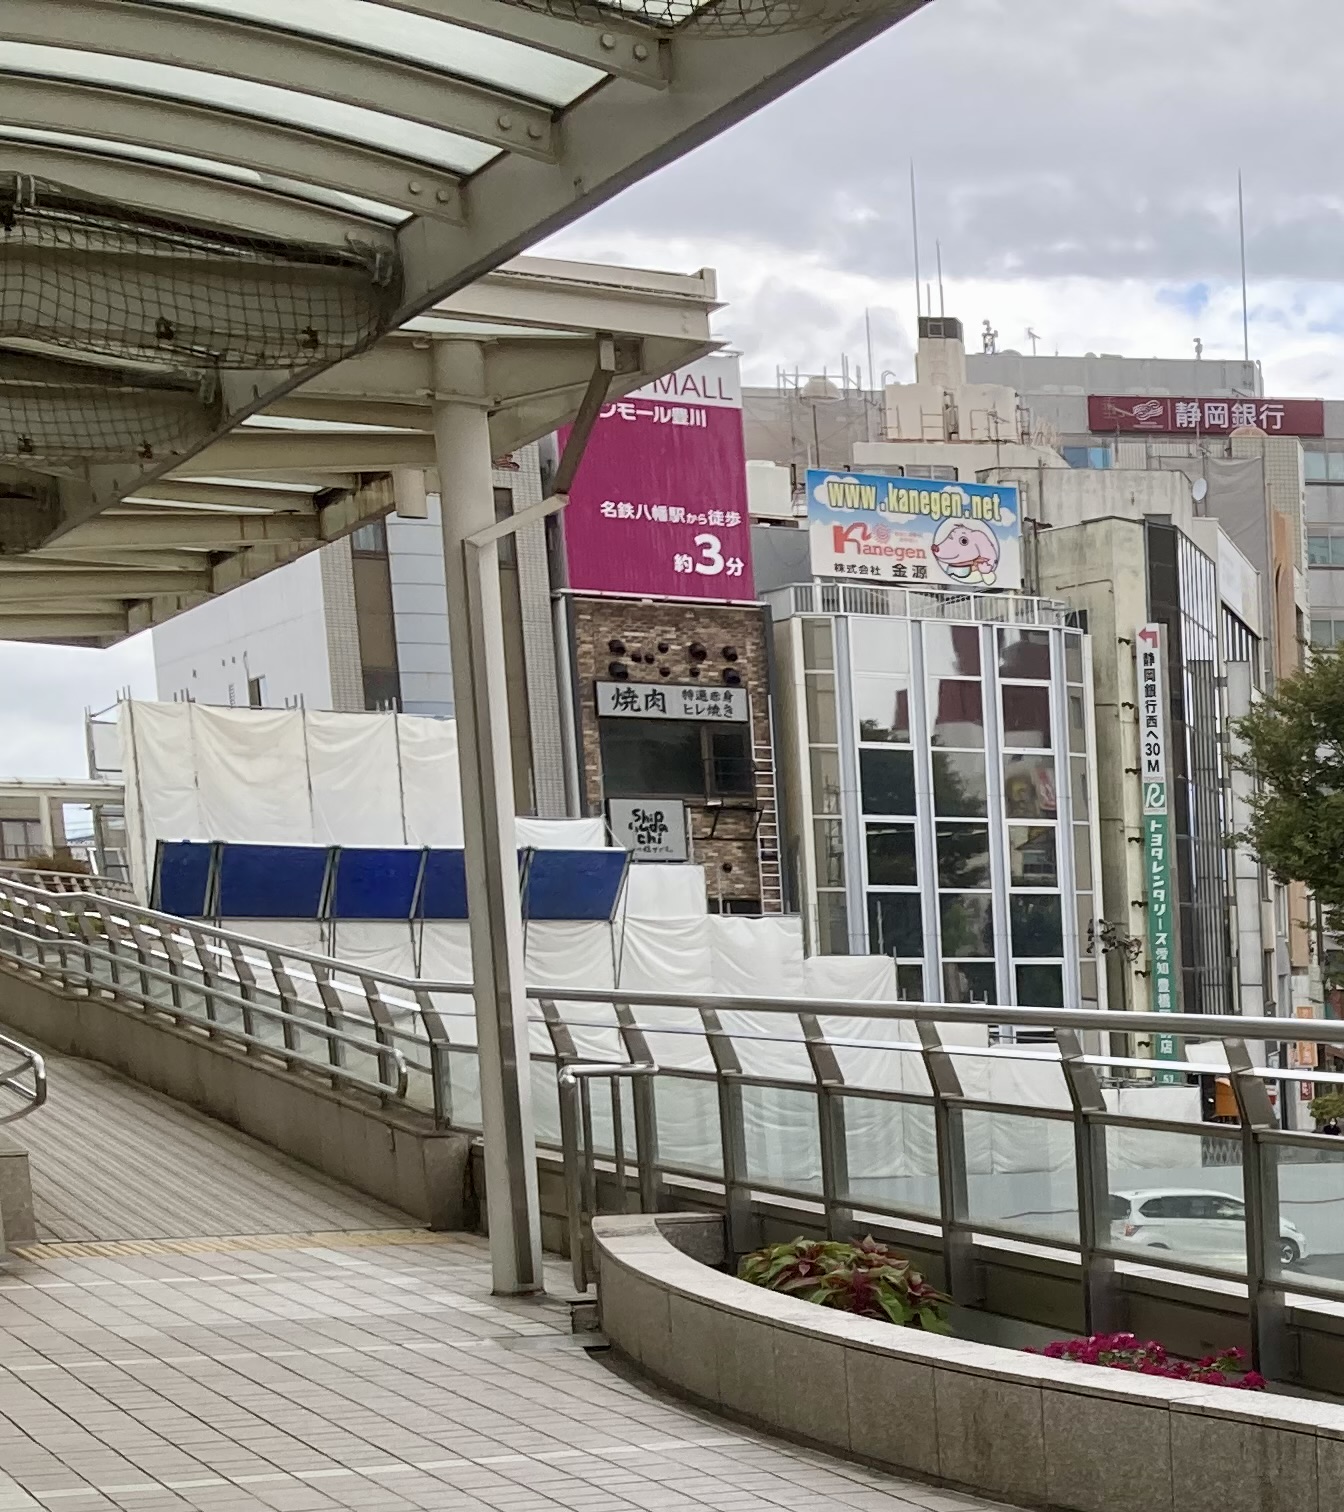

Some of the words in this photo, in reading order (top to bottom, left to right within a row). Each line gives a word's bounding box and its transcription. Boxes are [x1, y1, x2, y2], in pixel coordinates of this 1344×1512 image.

[599, 401, 708, 428] ンモール豊川
[1174, 401, 1285, 430] 静岡銀行
[600, 500, 742, 528] 名鉄八幡駅から徒歩
[673, 533, 745, 577] 約3分
[833, 562, 882, 577] 株式会社
[891, 563, 929, 580] 金源
[611, 685, 668, 715] 焼肉
[683, 703, 735, 719] ヒレ焼き
